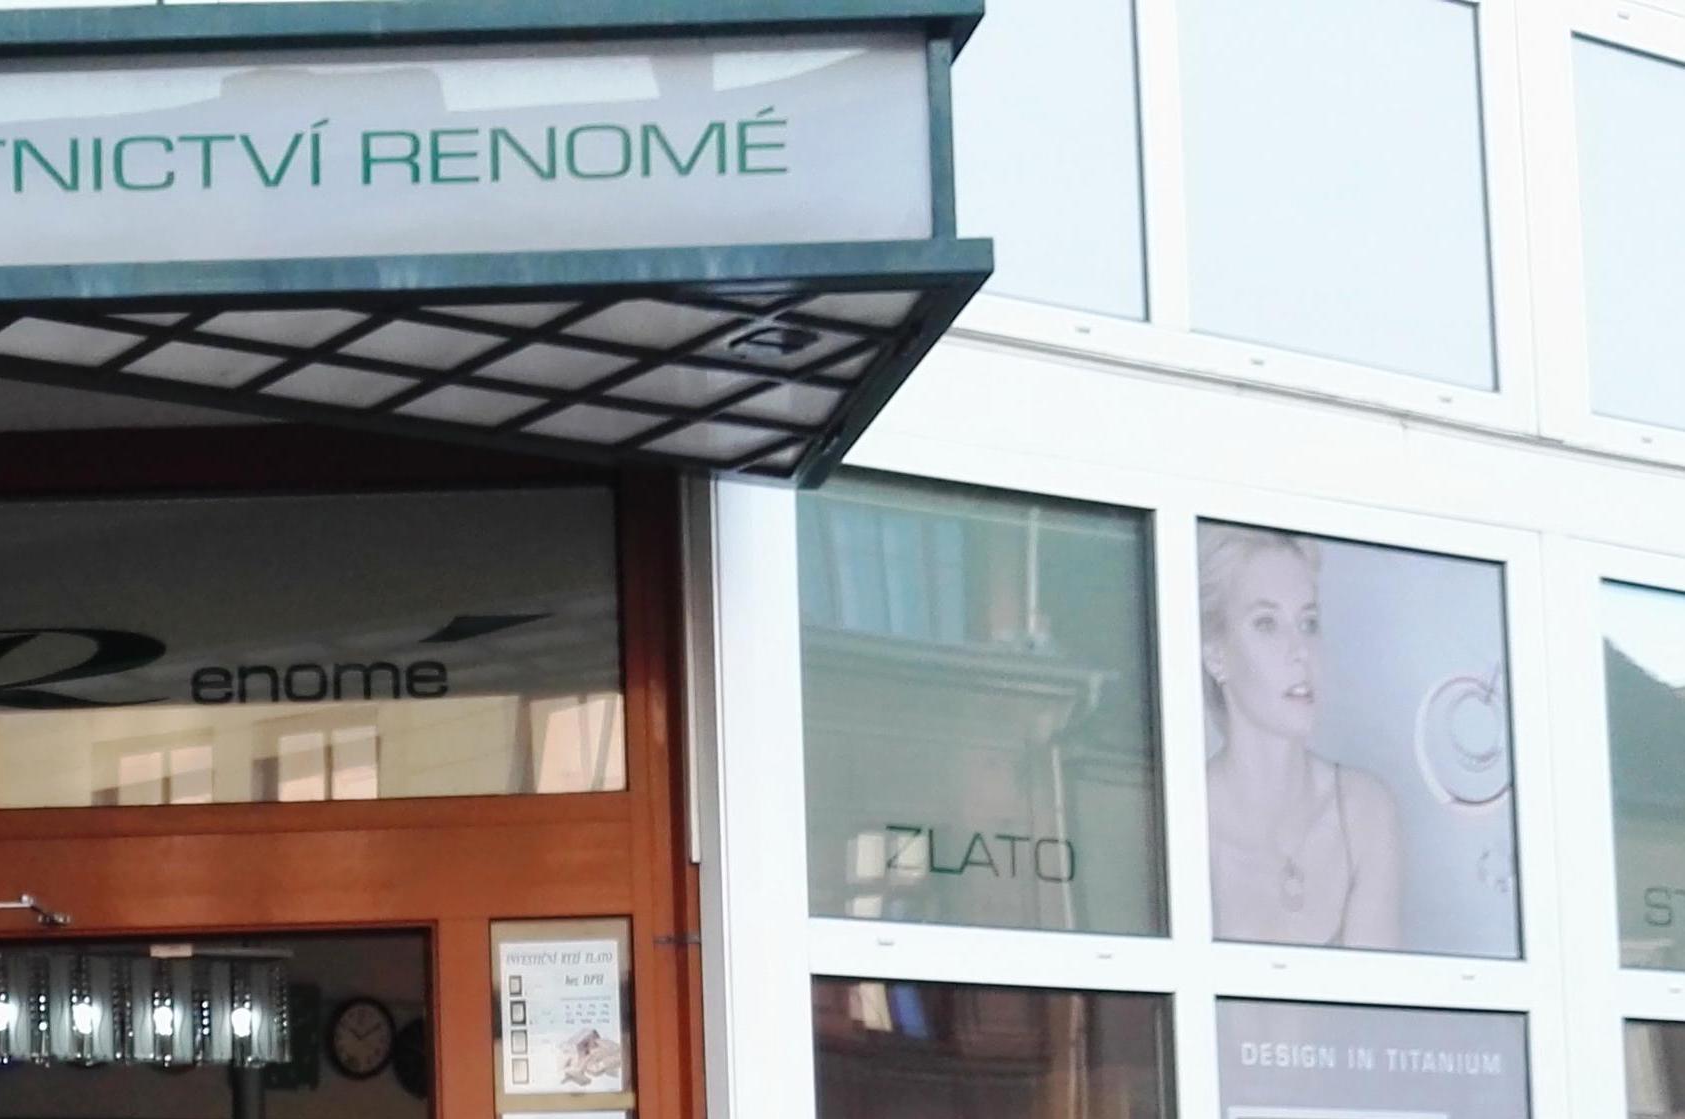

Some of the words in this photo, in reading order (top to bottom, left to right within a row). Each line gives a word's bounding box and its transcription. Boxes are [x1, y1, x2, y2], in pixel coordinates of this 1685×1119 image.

[358, 106, 791, 187] RENOMÉ
[886, 824, 1076, 882] ZLATO
[1240, 1042, 1336, 1069] DESIGN
[1347, 1048, 1374, 1071] IN
[1386, 1048, 1502, 1075] TITANIUM
